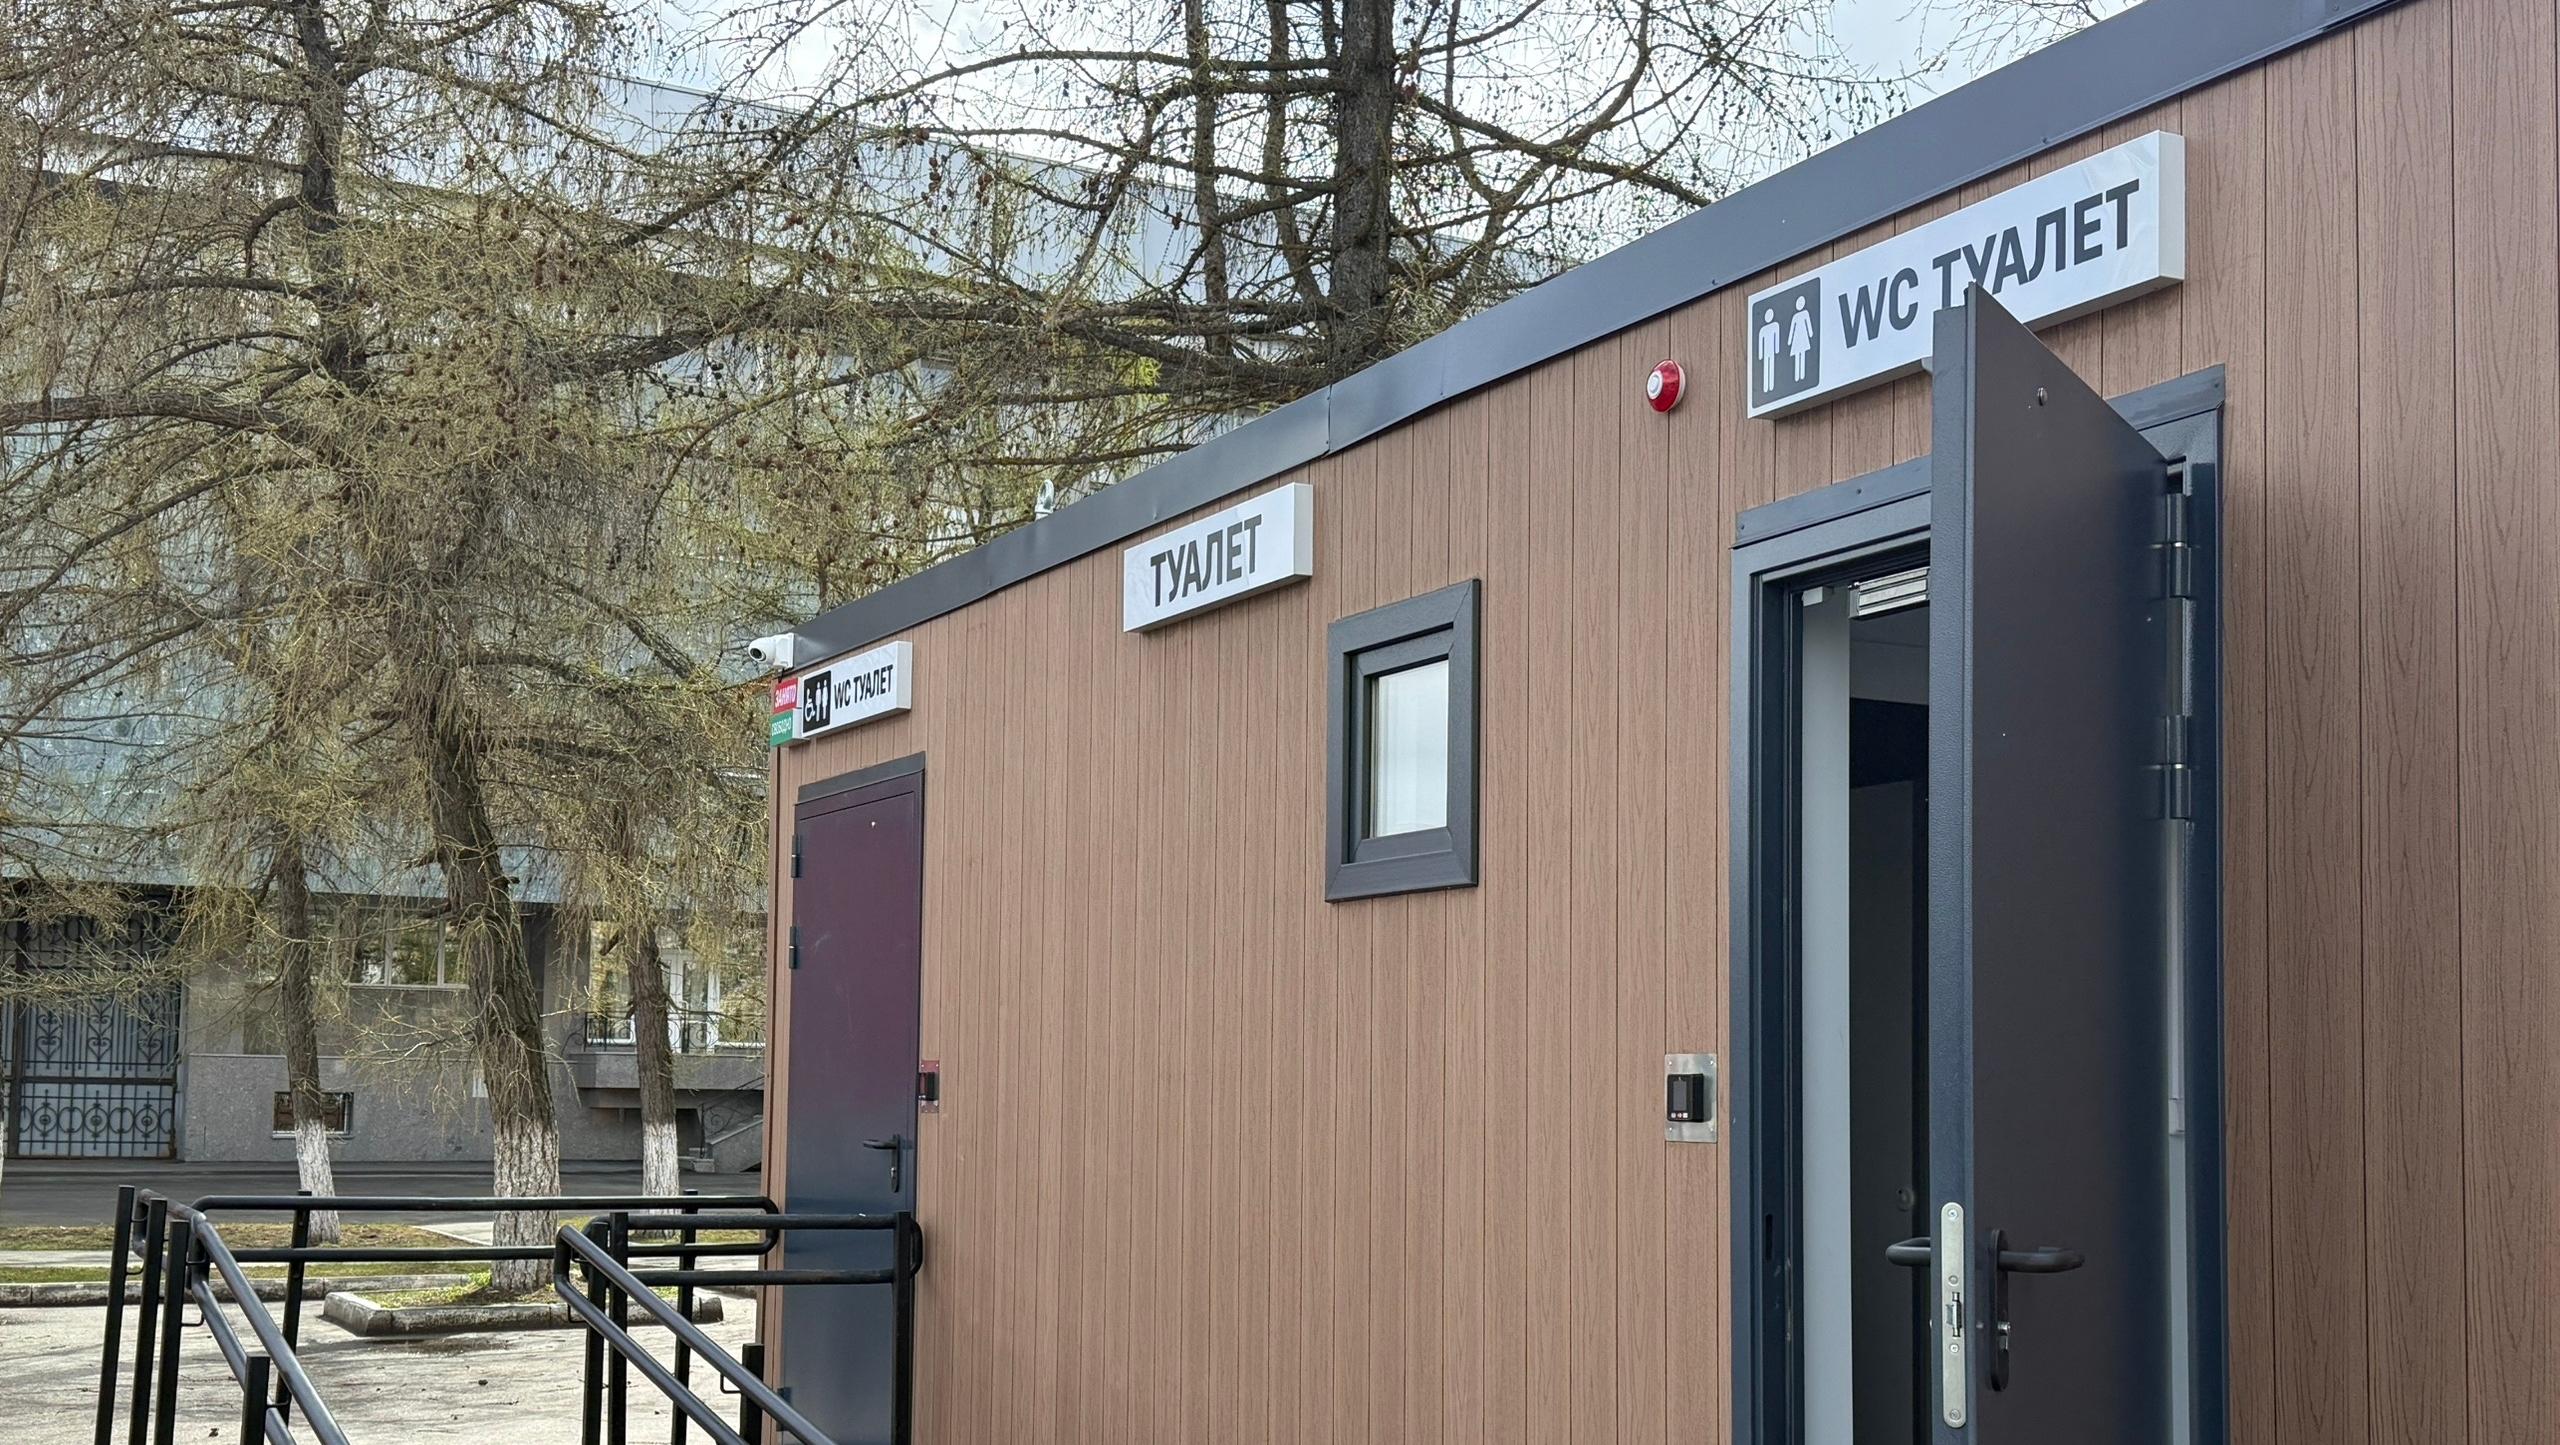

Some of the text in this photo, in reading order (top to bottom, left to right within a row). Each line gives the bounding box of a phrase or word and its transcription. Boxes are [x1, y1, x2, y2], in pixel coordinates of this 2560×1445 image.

[1838, 178, 2140, 349] WC ТУАЛЕТ
[1150, 513, 1262, 607] ТУАЛЕТ
[834, 664, 894, 709] WC ТУАЛЕТ
